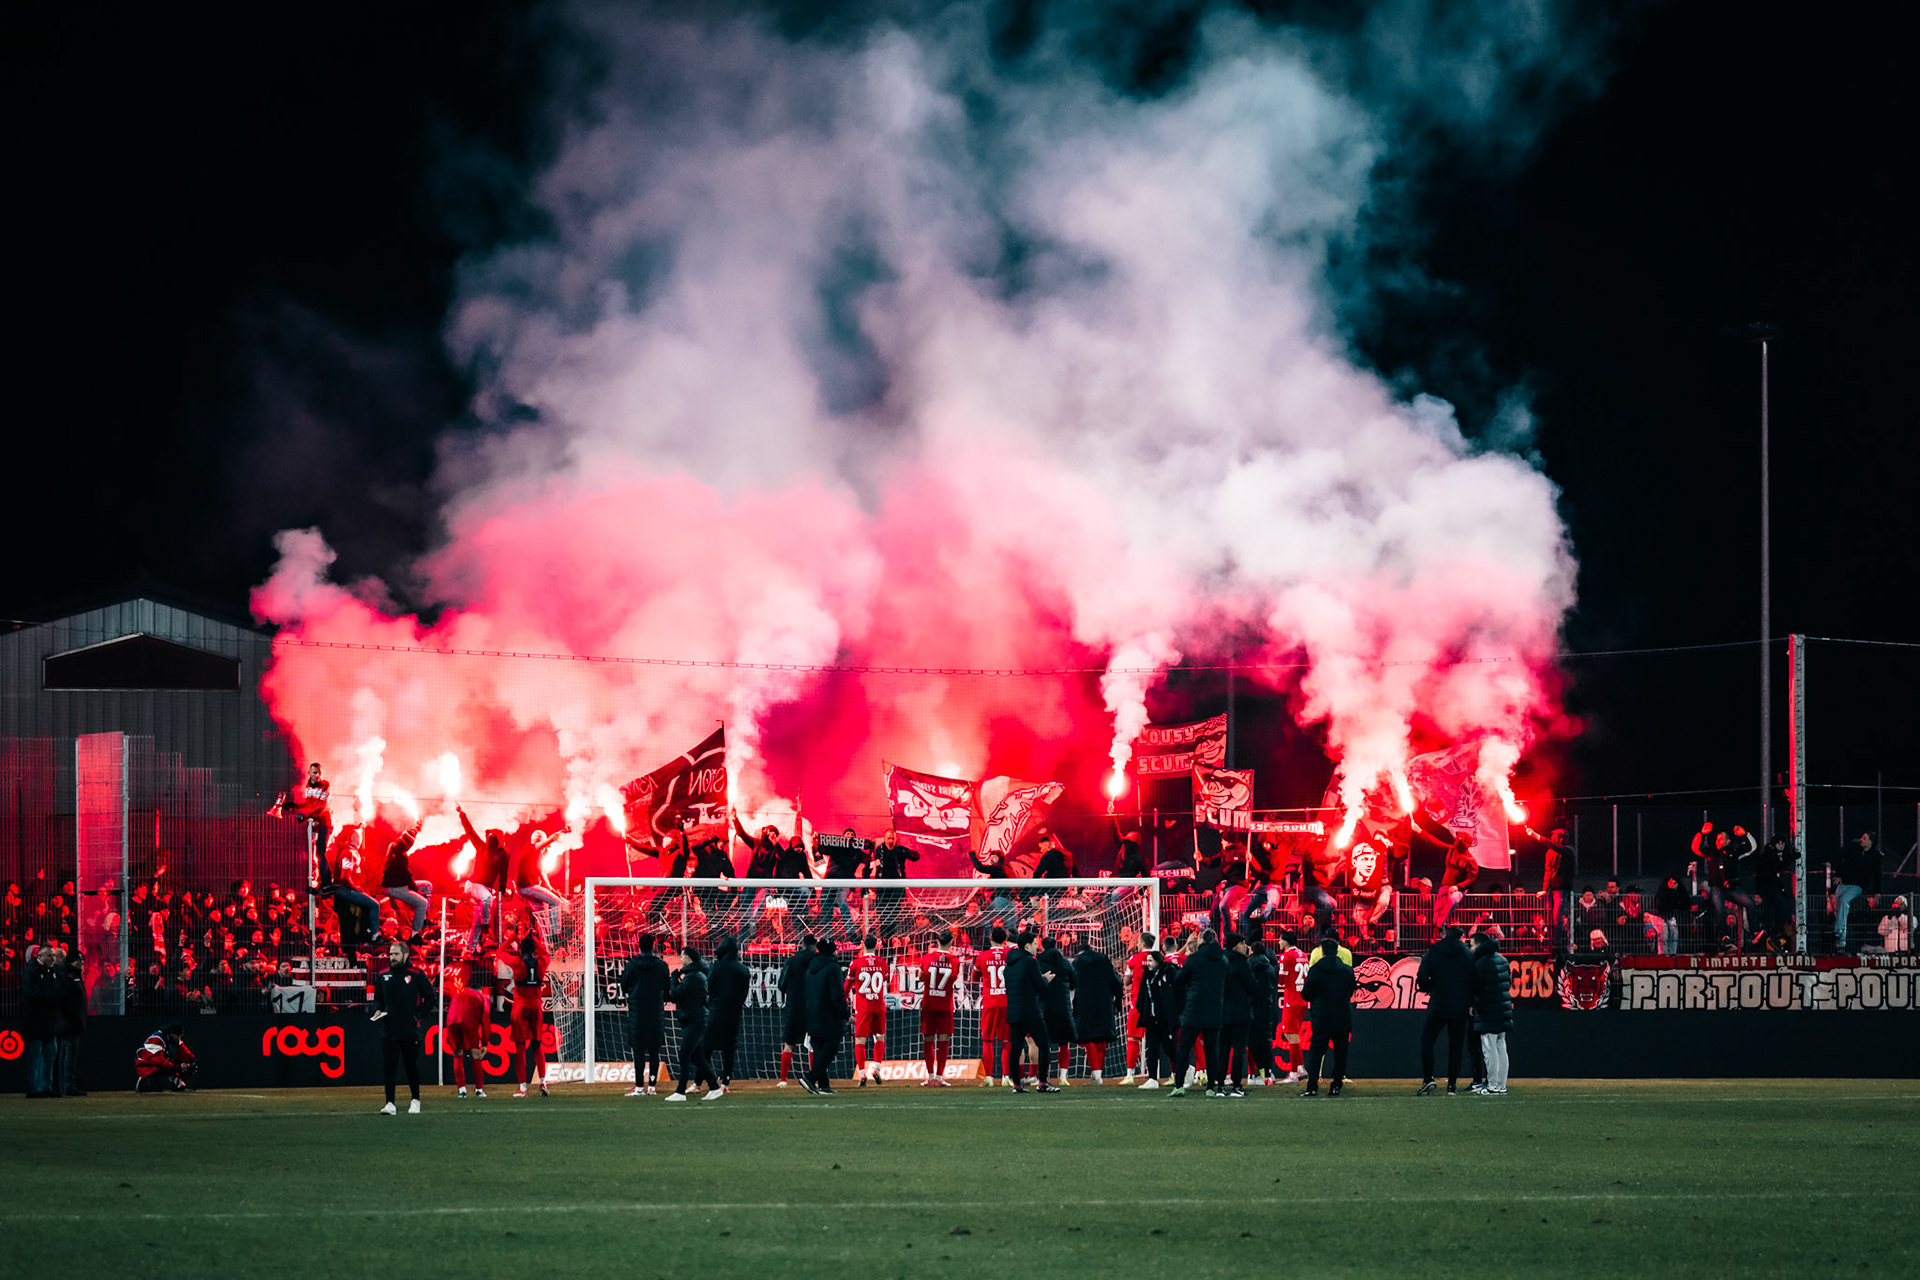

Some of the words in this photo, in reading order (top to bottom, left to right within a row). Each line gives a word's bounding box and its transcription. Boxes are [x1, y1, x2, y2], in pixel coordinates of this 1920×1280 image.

[1195, 804, 1250, 829] SCUM
[1860, 955, 1920, 967] N'IMPOR
[858, 971, 883, 994] 20
[928, 966, 952, 990] 17
[1631, 973, 1816, 1009] PARTOUT
[1835, 973, 1920, 1009] POU
